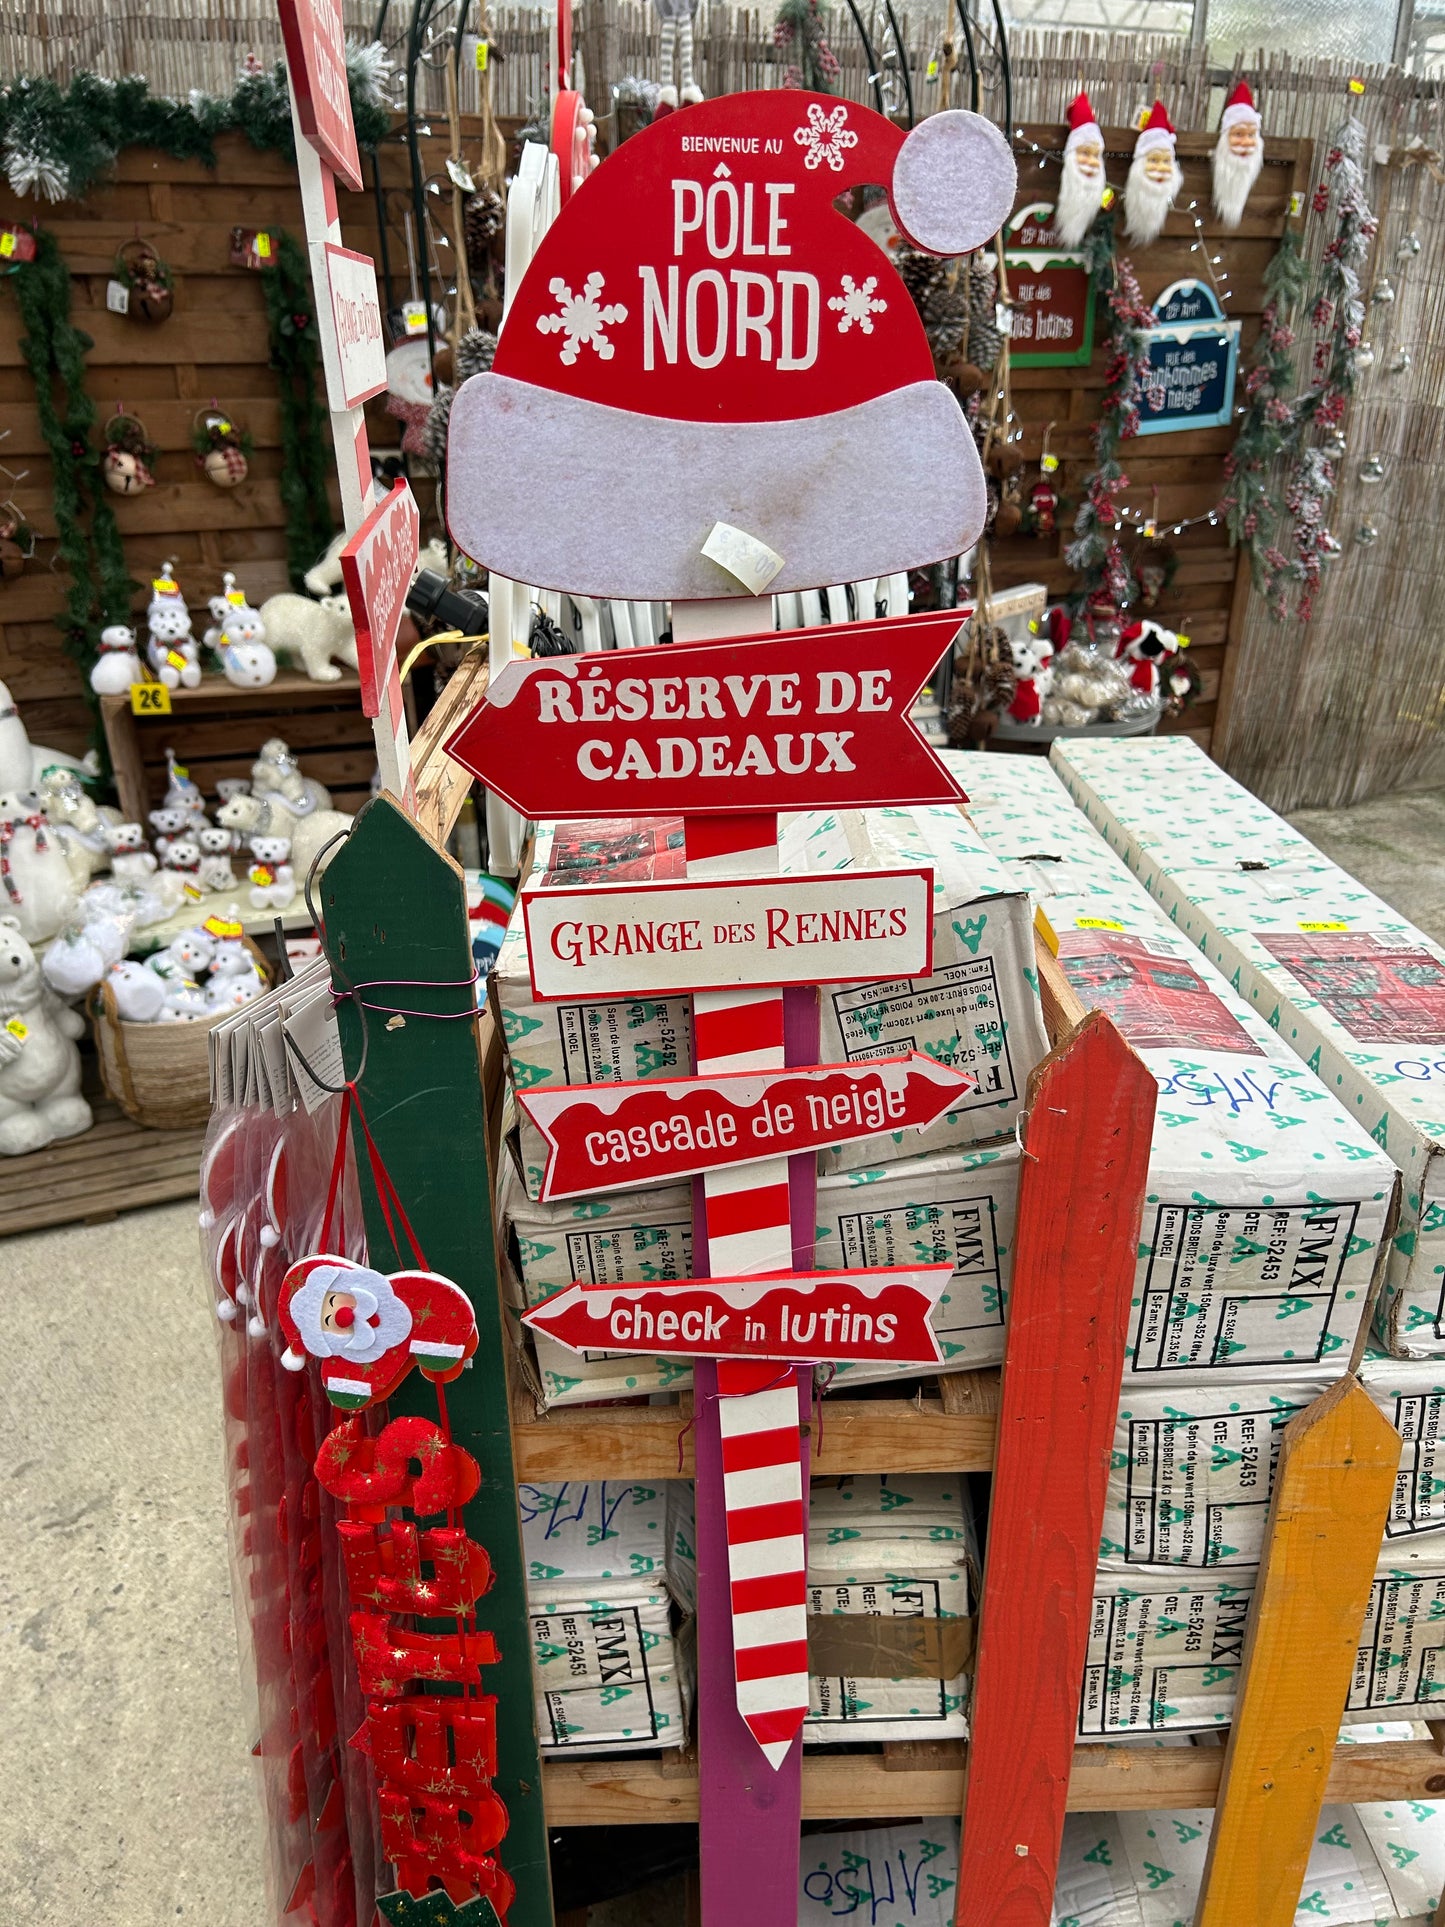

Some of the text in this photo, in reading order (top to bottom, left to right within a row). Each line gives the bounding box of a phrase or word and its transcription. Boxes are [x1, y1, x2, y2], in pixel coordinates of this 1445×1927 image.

[682, 136, 782, 154] BIENVENUE AU
[671, 162, 795, 258] PÔLE
[638, 265, 820, 371] NORD
[140, 689, 162, 708] 2€
[535, 666, 893, 724] RÉSERVE DE
[576, 731, 856, 781] CADEAUX
[550, 907, 908, 966] GRANGE DES RENNES
[943, 963, 989, 981] Fam: NOEL
[861, 982, 909, 1000] S-Fam: NSA
[890, 1000, 913, 1013] POIDS
[917, 982, 993, 1006] POIDS BRUT: KG
[631, 1005, 645, 1028] QTE:
[915, 1000, 995, 1022] Sapin de luxe vert
[565, 1012, 579, 1055] Fam: NOEL
[587, 1009, 605, 1081] POIDS BRUT: KG
[607, 1008, 624, 1082] Sapin de luxe vert
[656, 1004, 678, 1067] REF: 52452
[955, 1021, 999, 1042] QTE: 1
[977, 1041, 1002, 1054] REF:
[585, 1083, 906, 1167] cascade de neige
[845, 1219, 859, 1256] Fam: NOEL
[905, 1211, 917, 1230] QTE:
[927, 1207, 947, 1262] REF: 52452
[951, 1206, 985, 1270] FMX
[1159, 1210, 1179, 1257] Fam: NOEL
[1243, 1212, 1260, 1236] QTE:
[573, 1237, 587, 1274] Fam: NOEL
[611, 1233, 626, 1281] Sapin de luxe
[633, 1231, 646, 1250] QTE:
[657, 1229, 669, 1250] REF:
[1203, 1212, 1230, 1290] Sapin de luxe vert
[1260, 1212, 1290, 1281] REF: 52453
[1288, 1214, 1341, 1291] FMX
[1167, 1210, 1205, 1362] POIDS BRUT: 2.8 KG POIDS KG
[609, 1303, 898, 1343] check in lutins
[1145, 1295, 1164, 1344] S-Fam: NSA
[1404, 1400, 1417, 1420] Fam:
[1137, 1425, 1149, 1467] Fam: NOEL
[1186, 1424, 1200, 1449] Sapin
[1213, 1421, 1228, 1444] QTE:
[1423, 1397, 1441, 1468] POIDS 2.8 KG
[1161, 1423, 1174, 1495] POIDS BRUT: 2.8 KG
[1184, 1462, 1196, 1480] luxe
[1187, 1450, 1198, 1460] de
[1240, 1418, 1258, 1487] REF: 52453
[1395, 1474, 1408, 1520] S-Fam: NSA
[1134, 1500, 1145, 1545] S-Fam: NSA
[811, 1589, 823, 1611] Sapin
[836, 1587, 850, 1608] QTE:
[863, 1586, 876, 1608] REF:
[1139, 1598, 1152, 1619] Sapin
[1164, 1596, 1179, 1615] QTE:
[535, 1620, 550, 1641] QTE:
[1093, 1599, 1107, 1638] Fam: NOEL
[1115, 1618, 1128, 1638] BRUT:
[1138, 1619, 1149, 1629] de
[1185, 1594, 1205, 1652] REF: 52453
[1211, 1596, 1251, 1662] FMX
[561, 1618, 587, 1676] REF: 52453
[592, 1617, 633, 1683] FMX
[1113, 1651, 1124, 1661] KG
[1115, 1638, 1126, 1648] 2.8
[1136, 1630, 1148, 1647] luxe
[1088, 1669, 1100, 1710] S-Fam: NSA
[1355, 1675, 1366, 1690] NSA
[1109, 1716, 1120, 1725] KG
